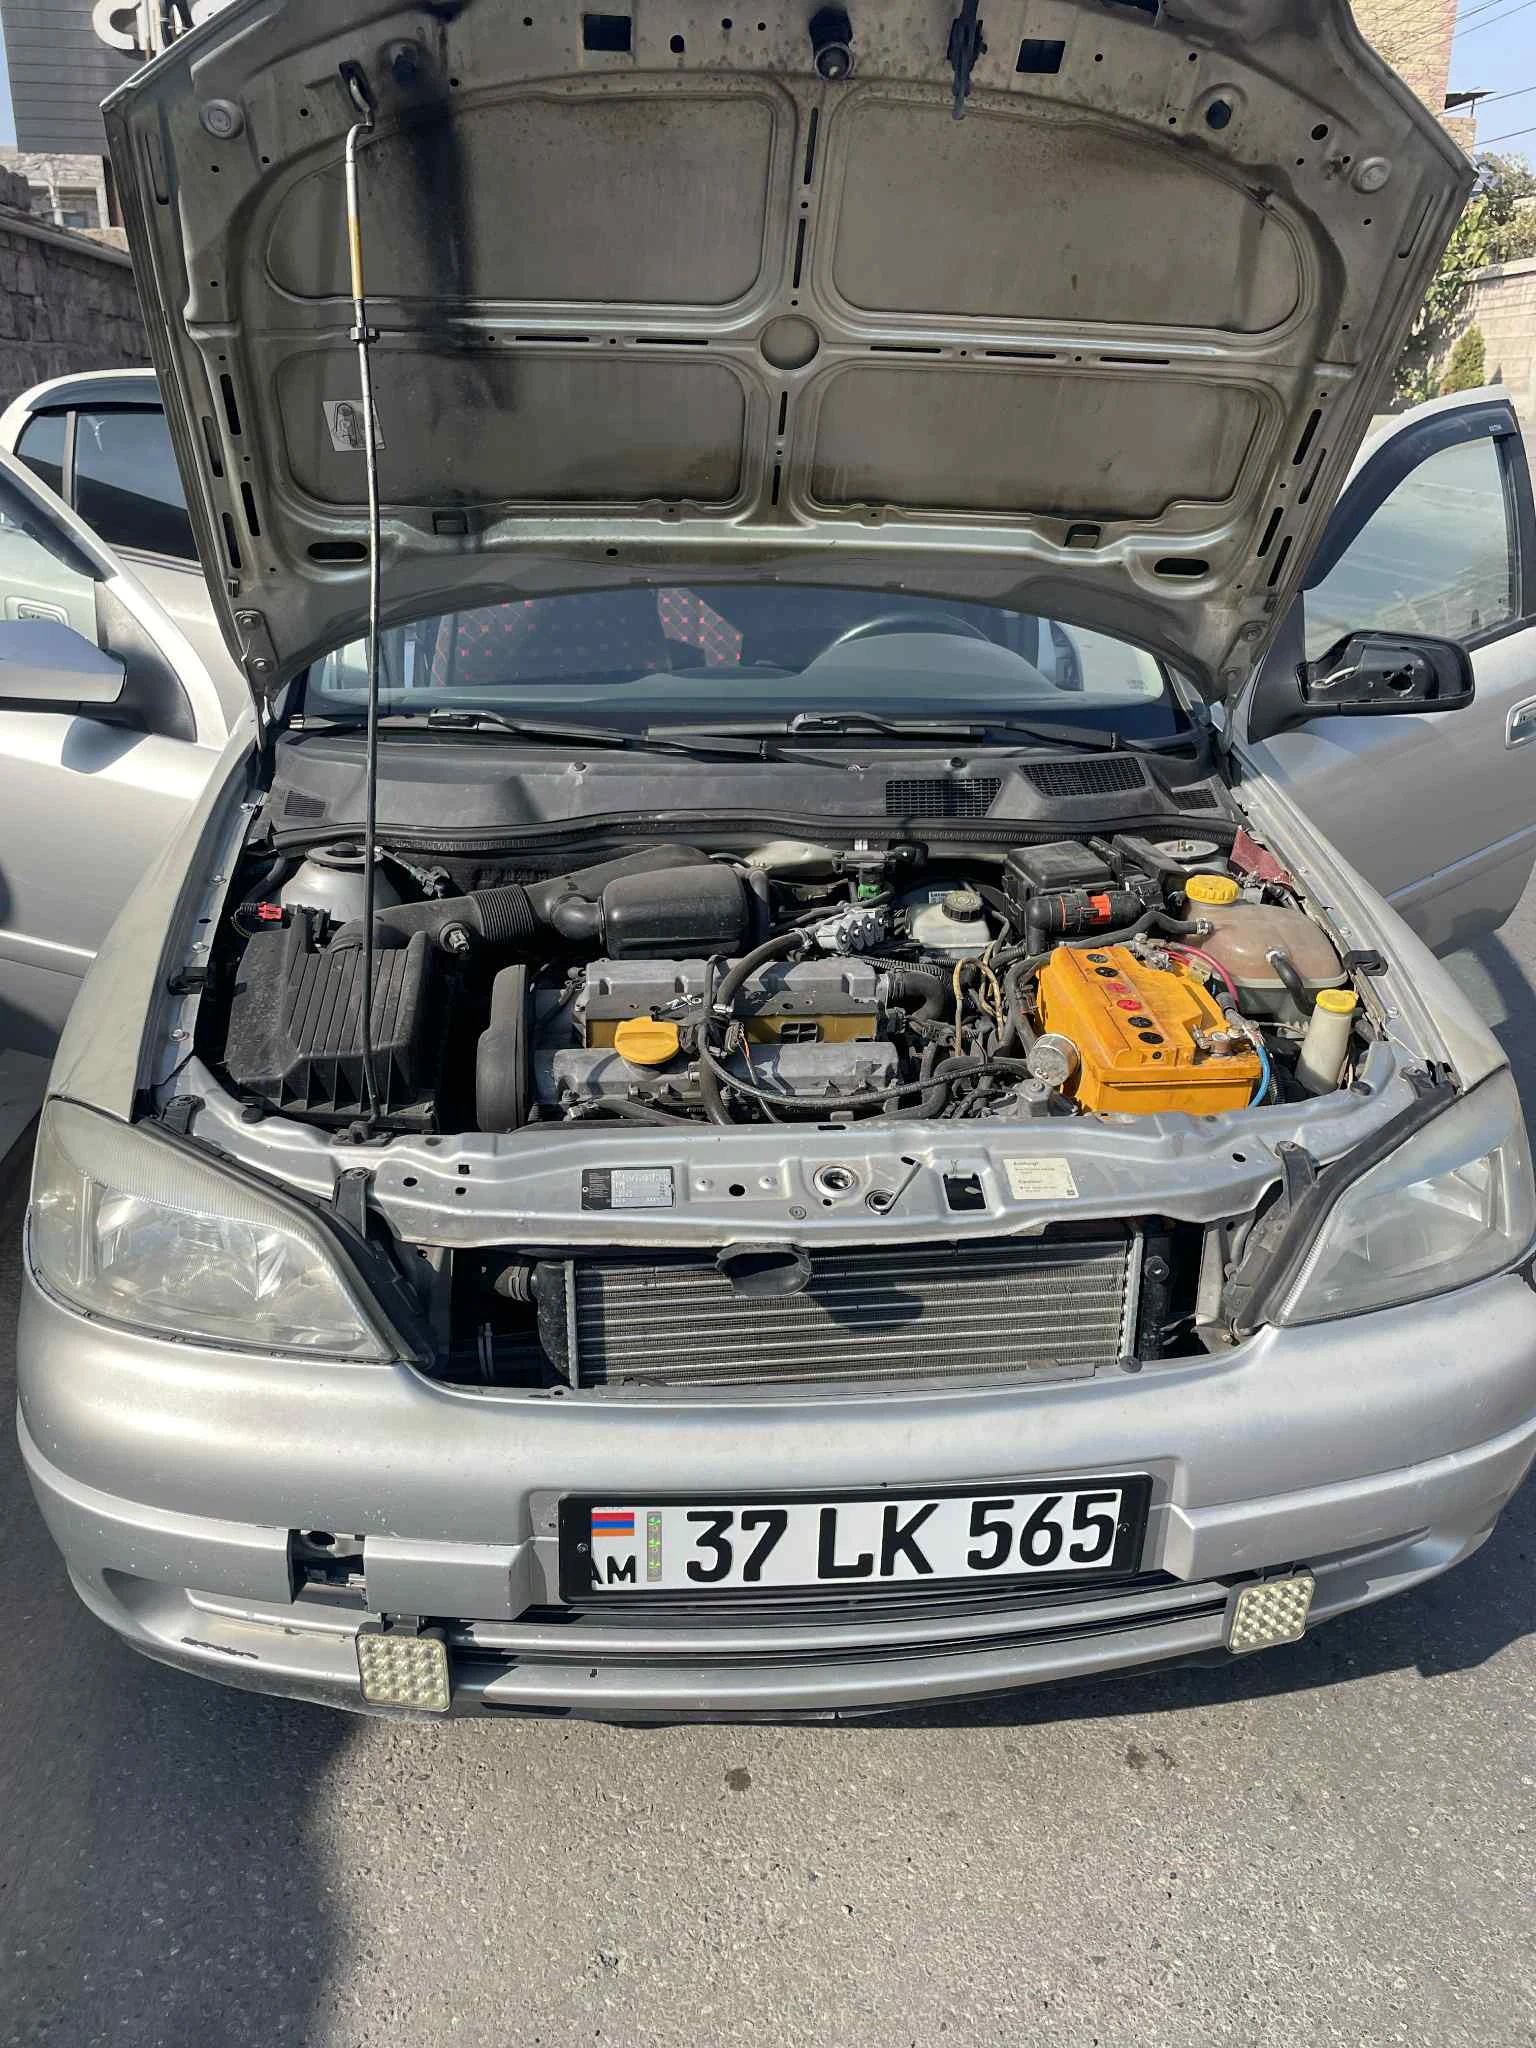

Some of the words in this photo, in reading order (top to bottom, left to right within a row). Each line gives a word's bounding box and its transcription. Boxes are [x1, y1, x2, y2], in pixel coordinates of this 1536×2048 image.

[686, 1509, 788, 1583] 37
[817, 1503, 940, 1579] LK
[967, 1492, 1117, 1570] 565
